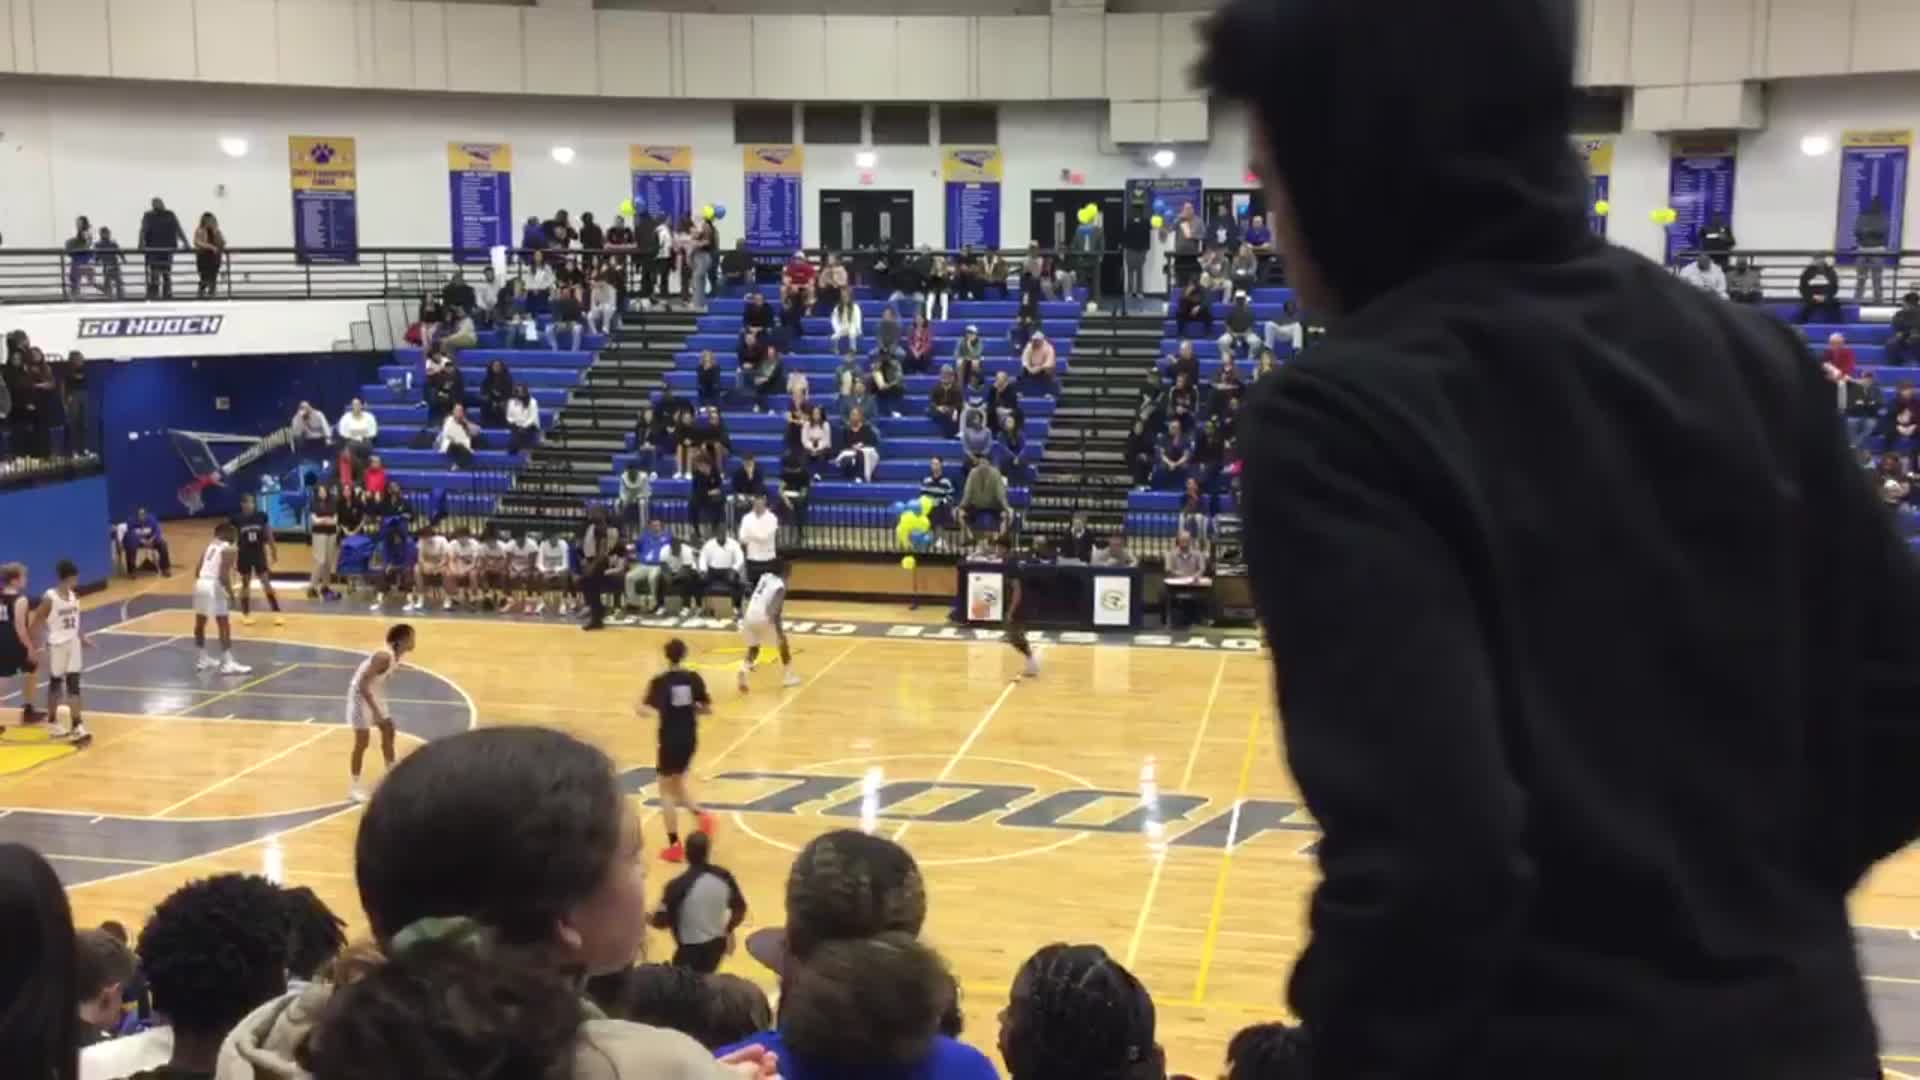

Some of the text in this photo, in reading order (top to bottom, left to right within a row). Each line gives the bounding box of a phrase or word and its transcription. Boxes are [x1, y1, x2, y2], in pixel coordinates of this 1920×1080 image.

[81, 317, 220, 336] GO HOOCH
[1132, 633, 1262, 650] OYS
